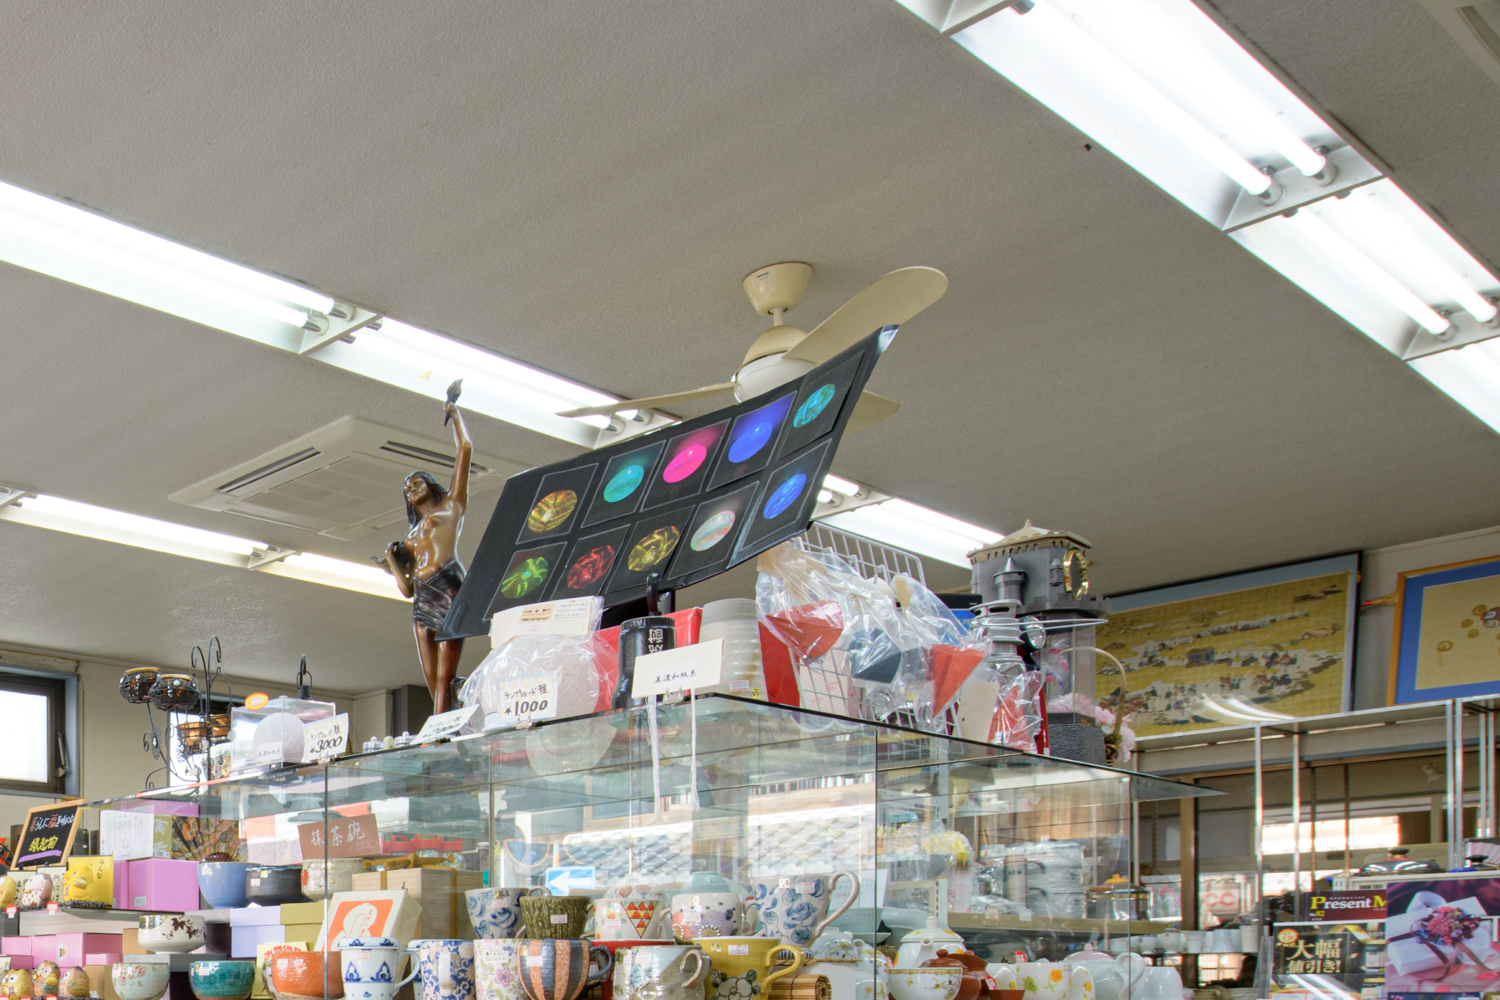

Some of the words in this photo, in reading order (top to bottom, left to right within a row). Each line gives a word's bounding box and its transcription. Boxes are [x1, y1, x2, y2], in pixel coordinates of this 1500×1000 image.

[310, 821, 366, 847] 抹茶碗
[1310, 896, 1372, 910] Present
[1286, 939, 1341, 960] 大幅
[1287, 960, 1341, 974] 値引き!
